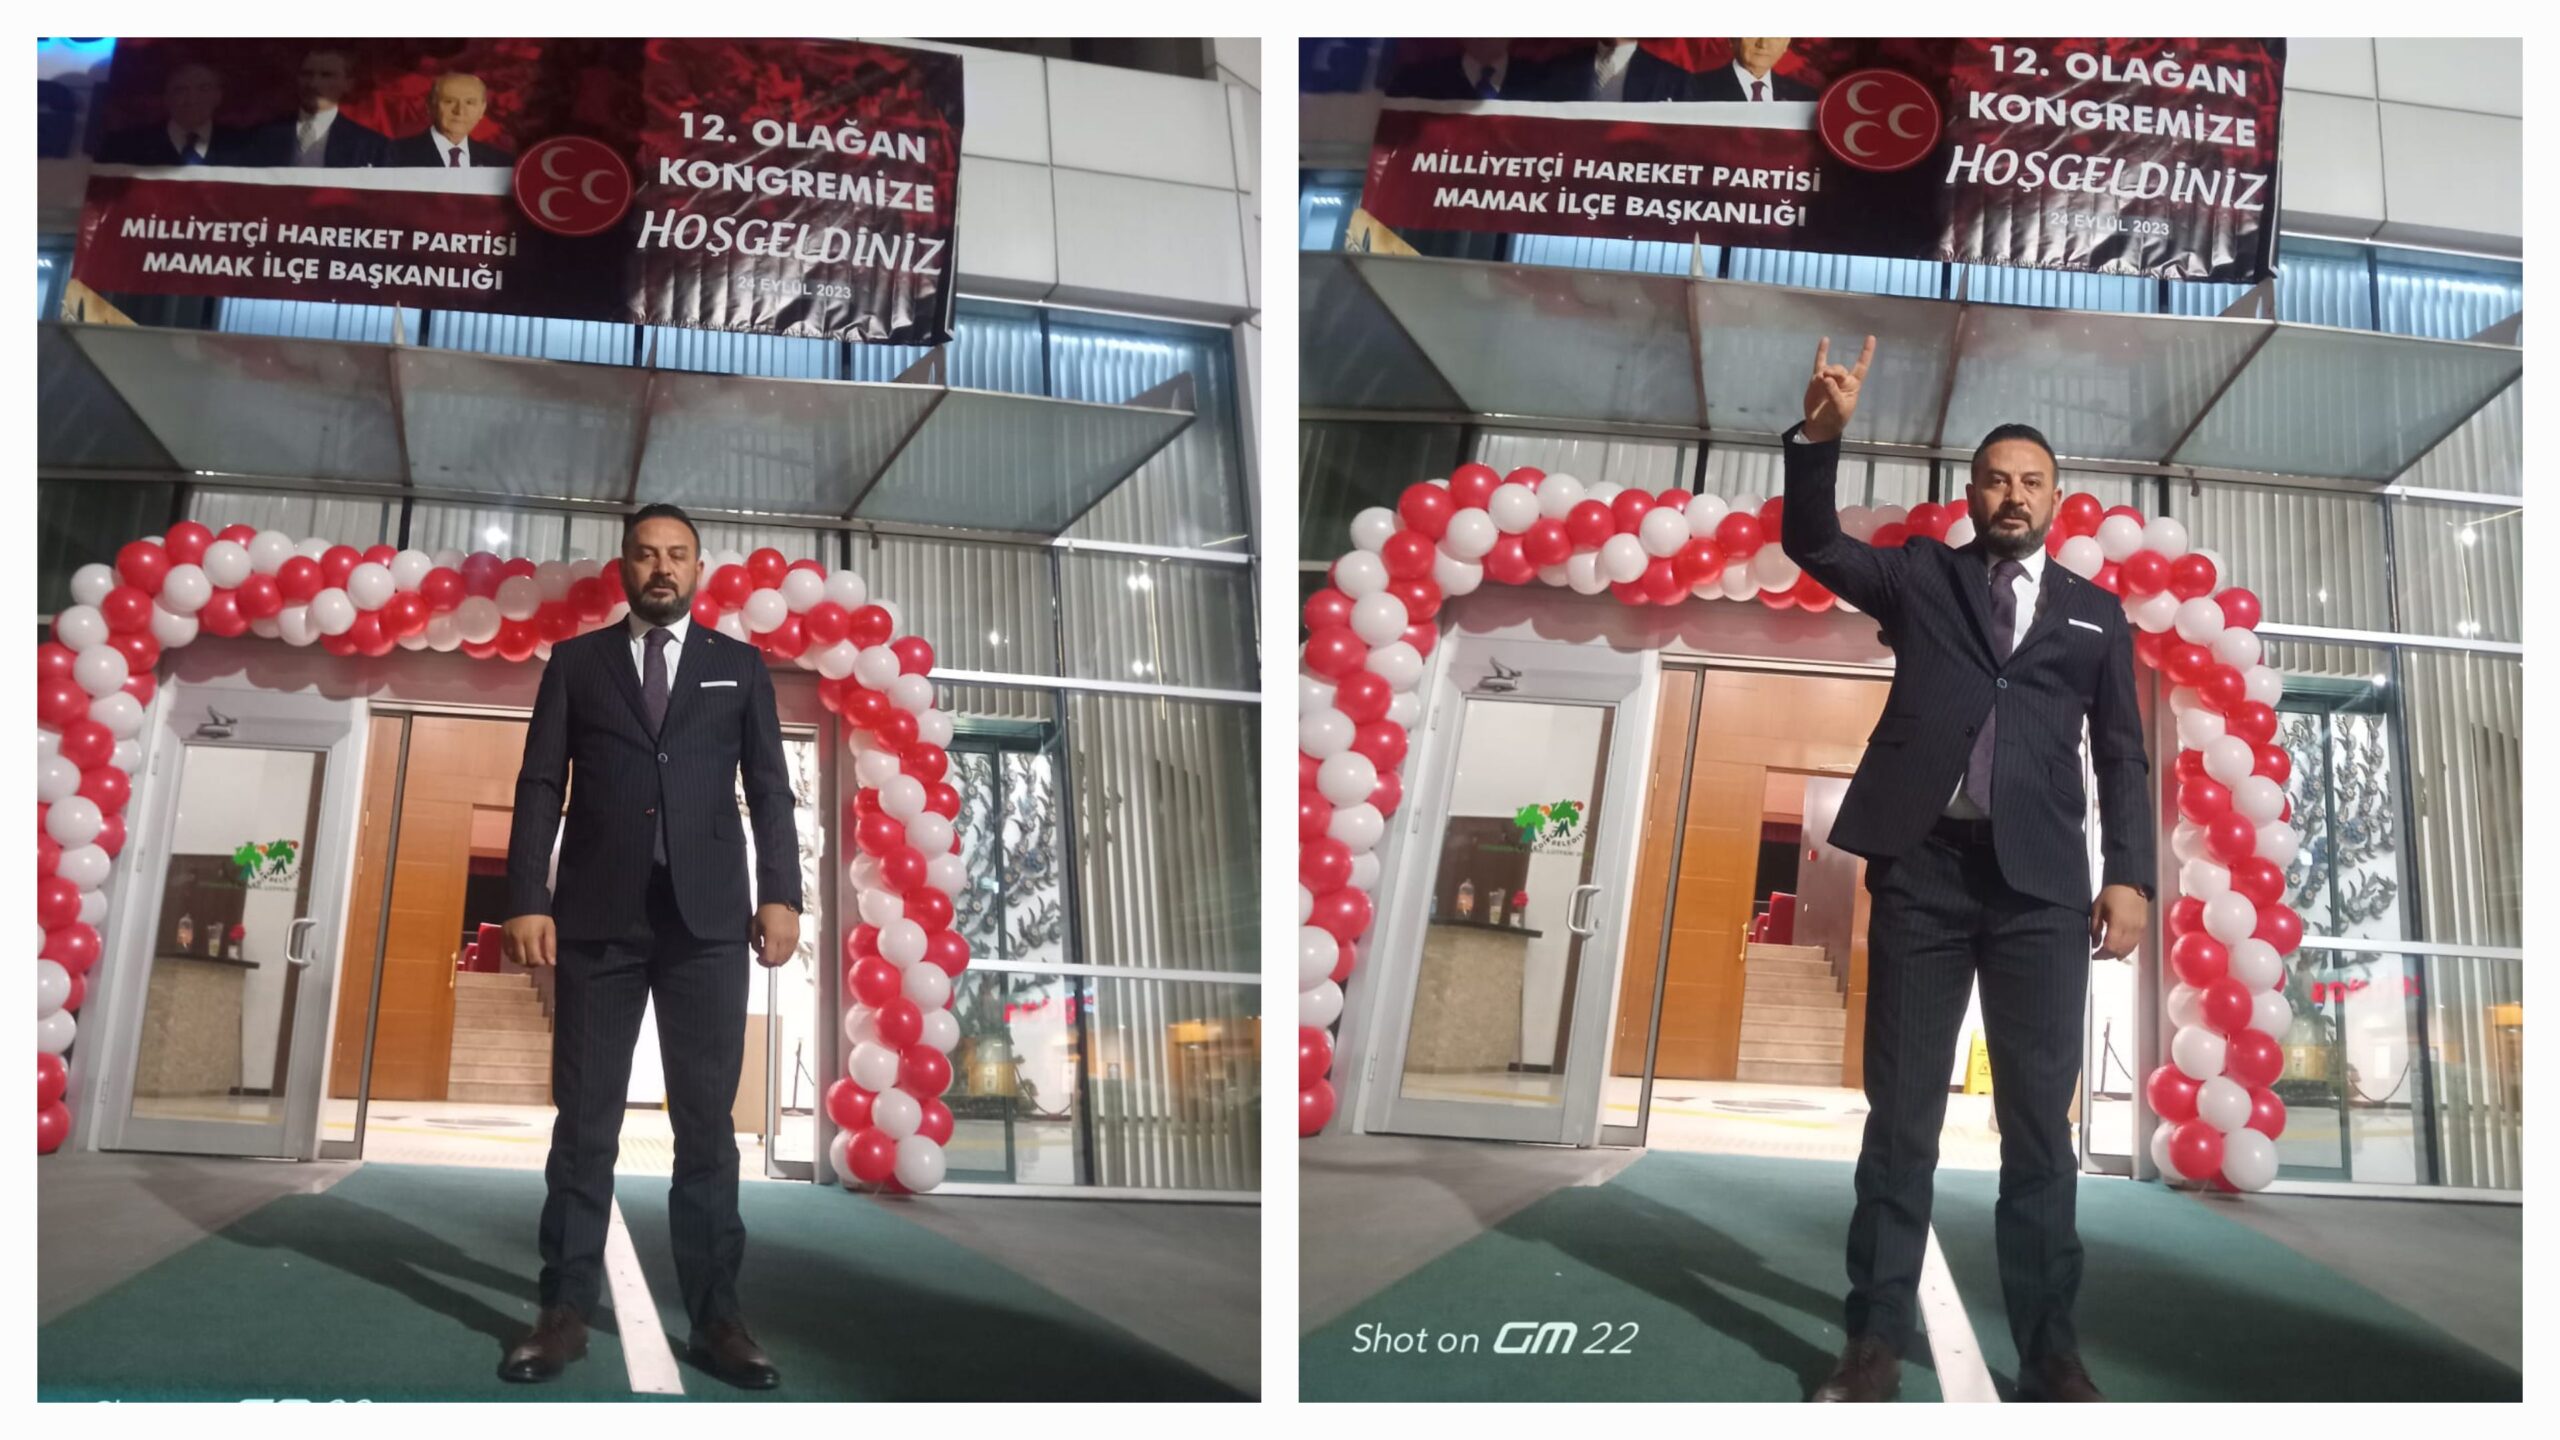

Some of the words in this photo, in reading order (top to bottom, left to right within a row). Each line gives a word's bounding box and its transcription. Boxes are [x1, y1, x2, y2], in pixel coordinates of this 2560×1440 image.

[1990, 45, 2050, 77] 12.
[2065, 51, 2247, 98] OLAĞAN
[679, 112, 737, 143] 12.
[752, 118, 926, 164] OLAĞAN
[1969, 91, 2256, 148] KONGREMİZE
[659, 157, 935, 212] KONGREMİZE
[1411, 148, 1564, 183] MİLLİYETÇİ
[1573, 158, 1704, 186] HAREKET
[1712, 165, 1821, 192] PARTİSİ
[1945, 143, 2268, 212] HOŞGELDİNİZ
[1433, 187, 1548, 213] MAMAK
[1557, 186, 1616, 220] İLÇE
[1625, 196, 1806, 227] BAŞKANLIĞI
[2050, 212, 2069, 227] 24
[2074, 213, 2128, 233] EYLÜL
[2132, 220, 2170, 236] 2023
[120, 213, 268, 247] MİLLİYETÇİ
[277, 223, 404, 250] HAREKET
[412, 230, 518, 257] PARTİSİ
[636, 208, 946, 276] HOŞGELDİNİZ
[142, 252, 254, 277] MAMAK
[262, 251, 319, 284] İLÇE
[328, 261, 503, 290] BAŞKANLIĞI
[737, 276, 756, 290] 24
[760, 277, 812, 296] EYLÜL
[816, 283, 852, 298] 2023
